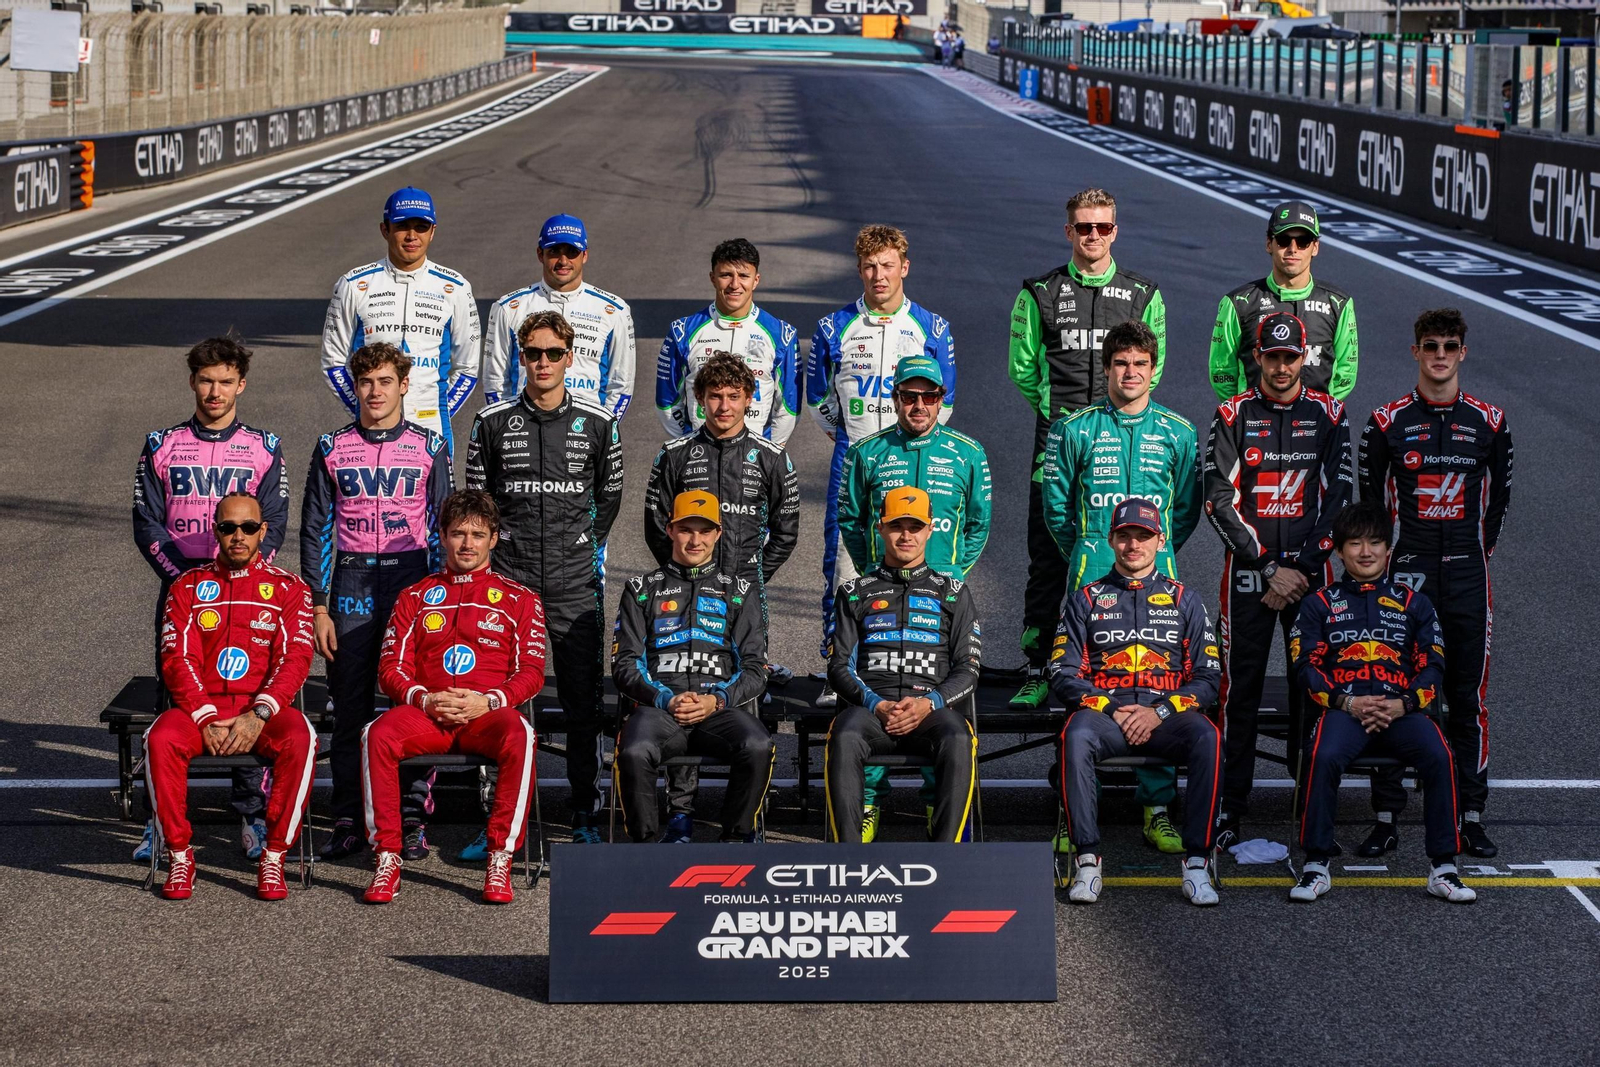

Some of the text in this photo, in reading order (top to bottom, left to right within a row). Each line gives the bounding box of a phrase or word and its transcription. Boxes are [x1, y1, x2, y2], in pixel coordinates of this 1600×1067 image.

[568, 15, 674, 32] ETIHAD
[729, 17, 835, 34] ETIHAD
[1143, 89, 1164, 131] ETIHAD
[1173, 95, 1197, 139] ETIHAD
[268, 113, 289, 148] ETIHAD
[297, 108, 316, 141] ETIHAD
[1208, 102, 1235, 150] ETIHAD
[235, 119, 259, 156] ETIHAD
[1249, 109, 1281, 163] ETIHAD
[197, 124, 223, 165] ETIHAD
[1298, 118, 1336, 177] ETIHAD
[135, 133, 184, 177] ETIHAD
[1357, 130, 1404, 196] ETIHAD
[15, 158, 60, 213] ETIHAD
[1432, 144, 1491, 221] ETIHAD
[1279, 209, 1290, 219] 5
[1300, 213, 1315, 225] KICK
[553, 225, 582, 233] ATLASSIAN
[369, 291, 396, 299] KOMATSU
[1102, 286, 1131, 301] KICK
[415, 302, 443, 311] DURACELL
[1304, 300, 1331, 315] KICK
[367, 311, 395, 319] Stephens
[415, 311, 442, 322] betway
[375, 324, 443, 337] MYPROTEIN
[570, 322, 599, 332] DURACELL
[573, 332, 597, 343] etway
[749, 333, 764, 341] VISA
[1060, 329, 1109, 350] KIC
[1219, 375, 1235, 383] BRB
[851, 375, 895, 399] VIS
[867, 404, 893, 414] Cash
[566, 441, 590, 449] INEOS
[911, 438, 931, 447] aramco
[1264, 452, 1317, 463] MoneyGram
[1424, 455, 1477, 465] MoneyGram
[611, 459, 622, 470] IWC
[878, 461, 908, 469] MAADEN
[927, 466, 953, 474] aramco
[1094, 467, 1119, 475] JCB
[743, 469, 762, 478] NEOS
[878, 469, 908, 478] cognizant
[168, 465, 255, 498] BWT
[335, 466, 423, 499] BWT
[504, 481, 584, 493] PETRONAS
[882, 479, 904, 487] BOSS
[926, 488, 952, 496] CoreWeave
[1119, 507, 1128, 517] 1
[1258, 502, 1302, 515] HAAS
[1419, 505, 1464, 518] HAAS
[174, 513, 208, 533] eni
[346, 513, 376, 533] eni
[1210, 514, 1237, 550] MoneyGram
[155, 554, 181, 577] BWT
[230, 568, 249, 579] IBM
[453, 574, 473, 583] IBM
[1236, 570, 1263, 593] 31
[199, 581, 217, 600] hp
[425, 586, 444, 604] hp
[655, 587, 682, 597] Android
[866, 588, 894, 598] Android
[338, 596, 374, 615] FC43
[911, 616, 938, 627] allwyn
[1091, 613, 1113, 621] Mobil
[1326, 614, 1345, 624] Mobil
[250, 621, 276, 632] UniCredit
[477, 621, 504, 633] UniCredit
[251, 637, 271, 645] CEVA
[478, 637, 500, 646] CEVA
[889, 630, 937, 643] Technologies
[1093, 629, 1179, 644] ORACLE
[1329, 629, 1406, 645] ORACLE
[219, 647, 247, 680] hp
[445, 645, 472, 675] hp
[657, 652, 722, 676] OKX
[867, 651, 937, 676] OKX
[1094, 671, 1180, 691] Red Bull
[1332, 664, 1409, 690] Red Bull
[946, 692, 963, 704] RICHARD
[766, 864, 937, 886] ETIHAD
[705, 893, 902, 903] FORMULA 1 ETIHAD AIRWAYS
[711, 911, 896, 933] ABU DHABI
[698, 936, 910, 958] GRAND PRIX
[779, 966, 830, 977] 2025
